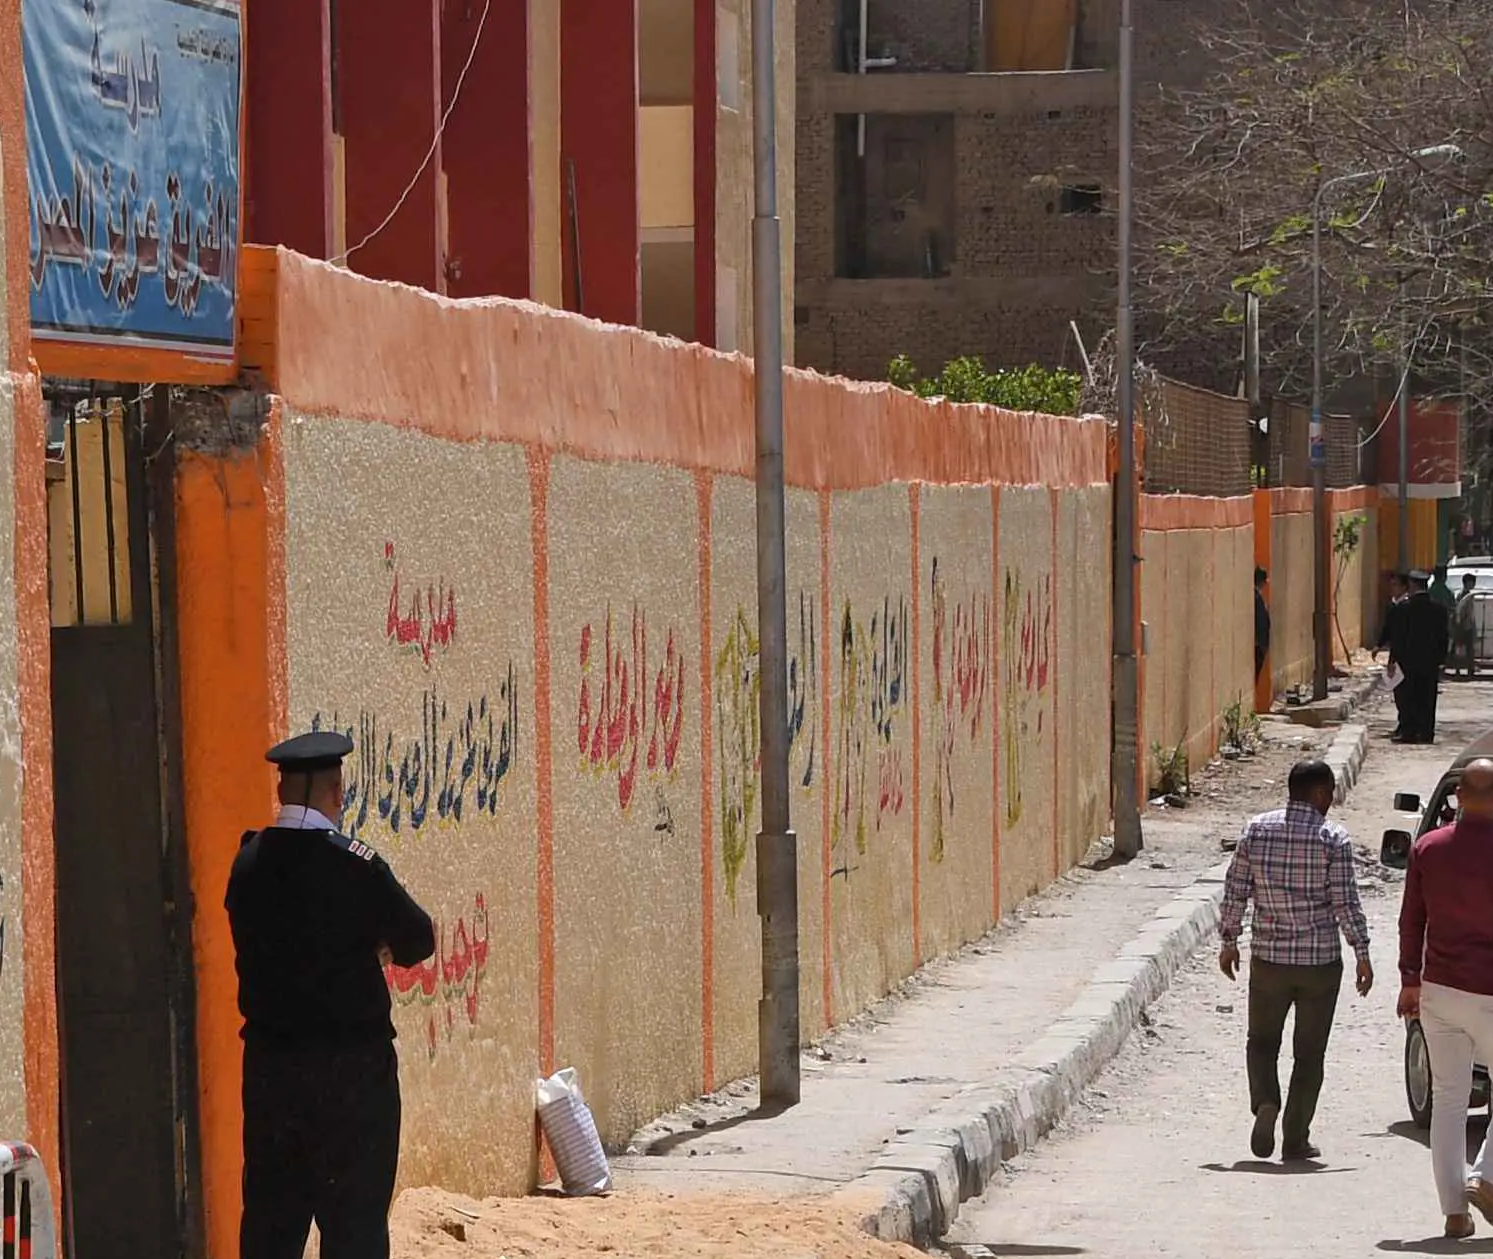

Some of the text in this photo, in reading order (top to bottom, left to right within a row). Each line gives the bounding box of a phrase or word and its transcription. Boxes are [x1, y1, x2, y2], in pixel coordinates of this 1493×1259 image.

[97, 161, 159, 311] عزيز
[164, 171, 231, 318] الفريق
[384, 542, 457, 666] مدرسة
